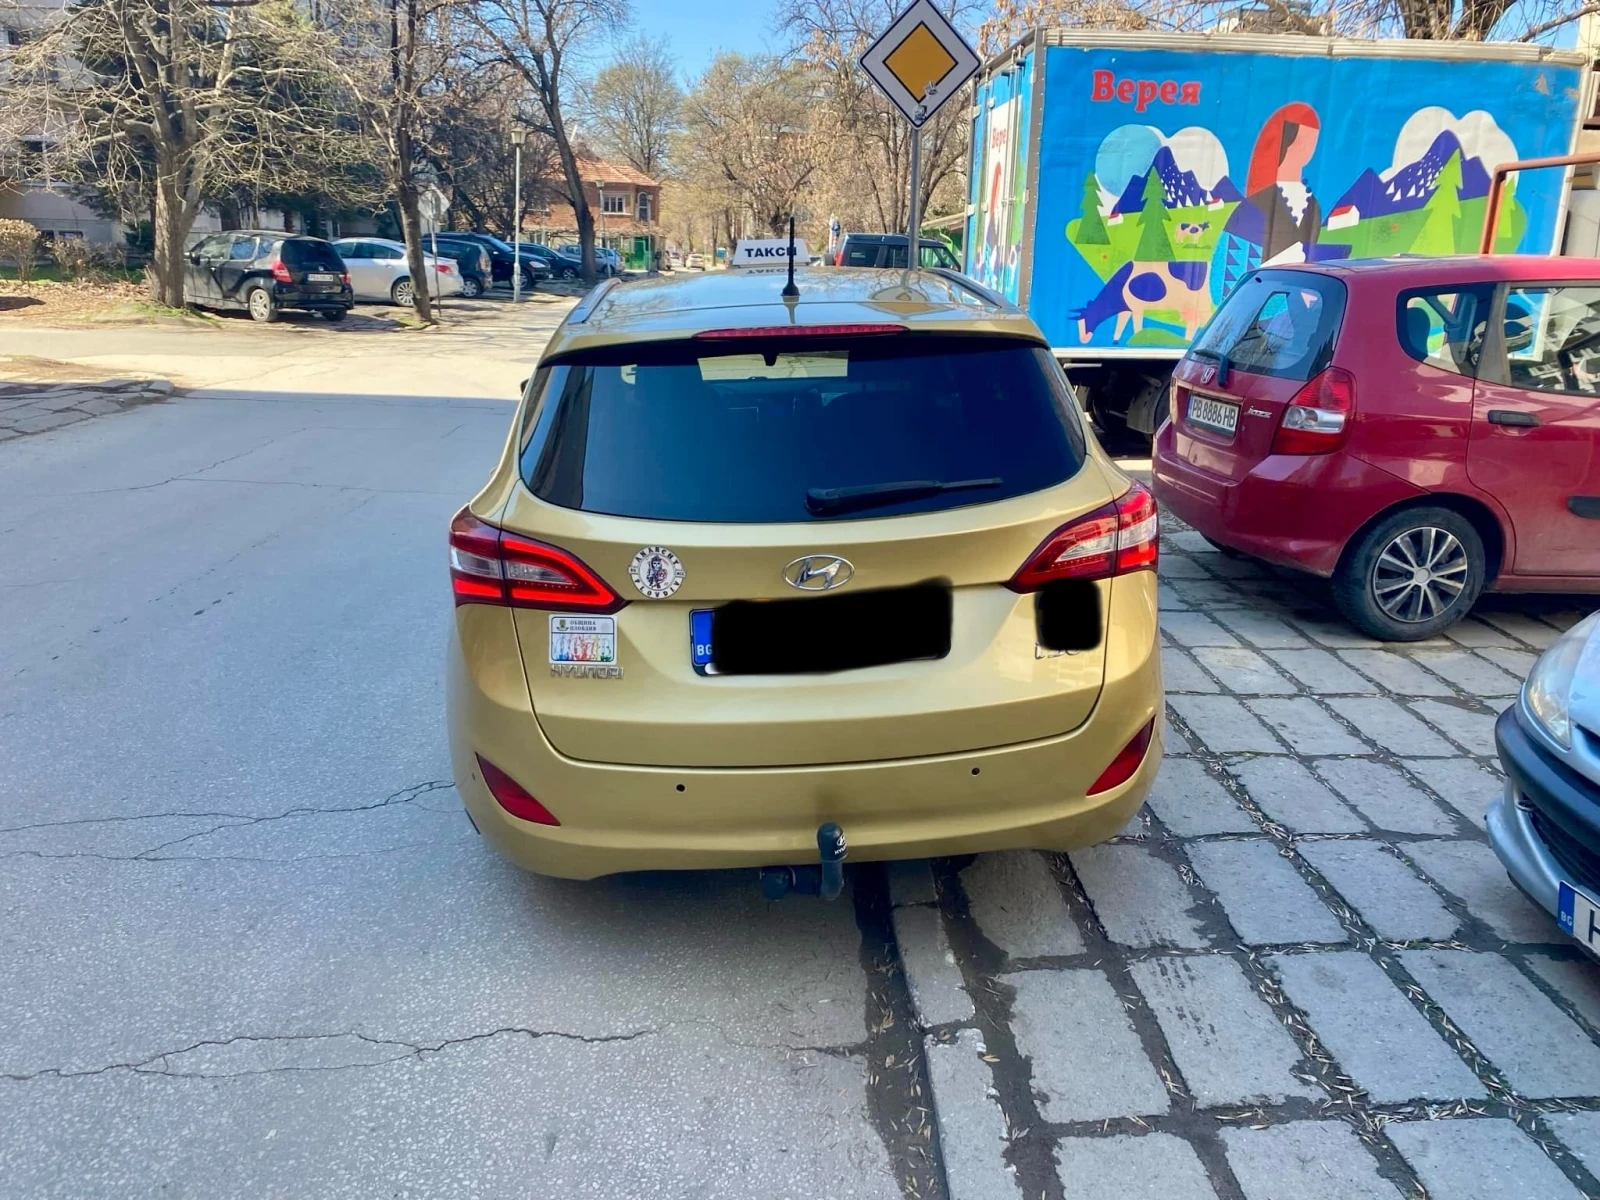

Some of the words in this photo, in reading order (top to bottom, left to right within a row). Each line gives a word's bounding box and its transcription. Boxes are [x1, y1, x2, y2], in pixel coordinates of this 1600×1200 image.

[1091, 70, 1201, 113] Верея
[1192, 398, 1203, 418] PB
[634, 546, 680, 565] ANARCHY
[634, 579, 680, 598] PLOVDIV
[697, 644, 712, 656] BG
[551, 664, 624, 680] HYUNDAI
[1560, 910, 1573, 926] BG
